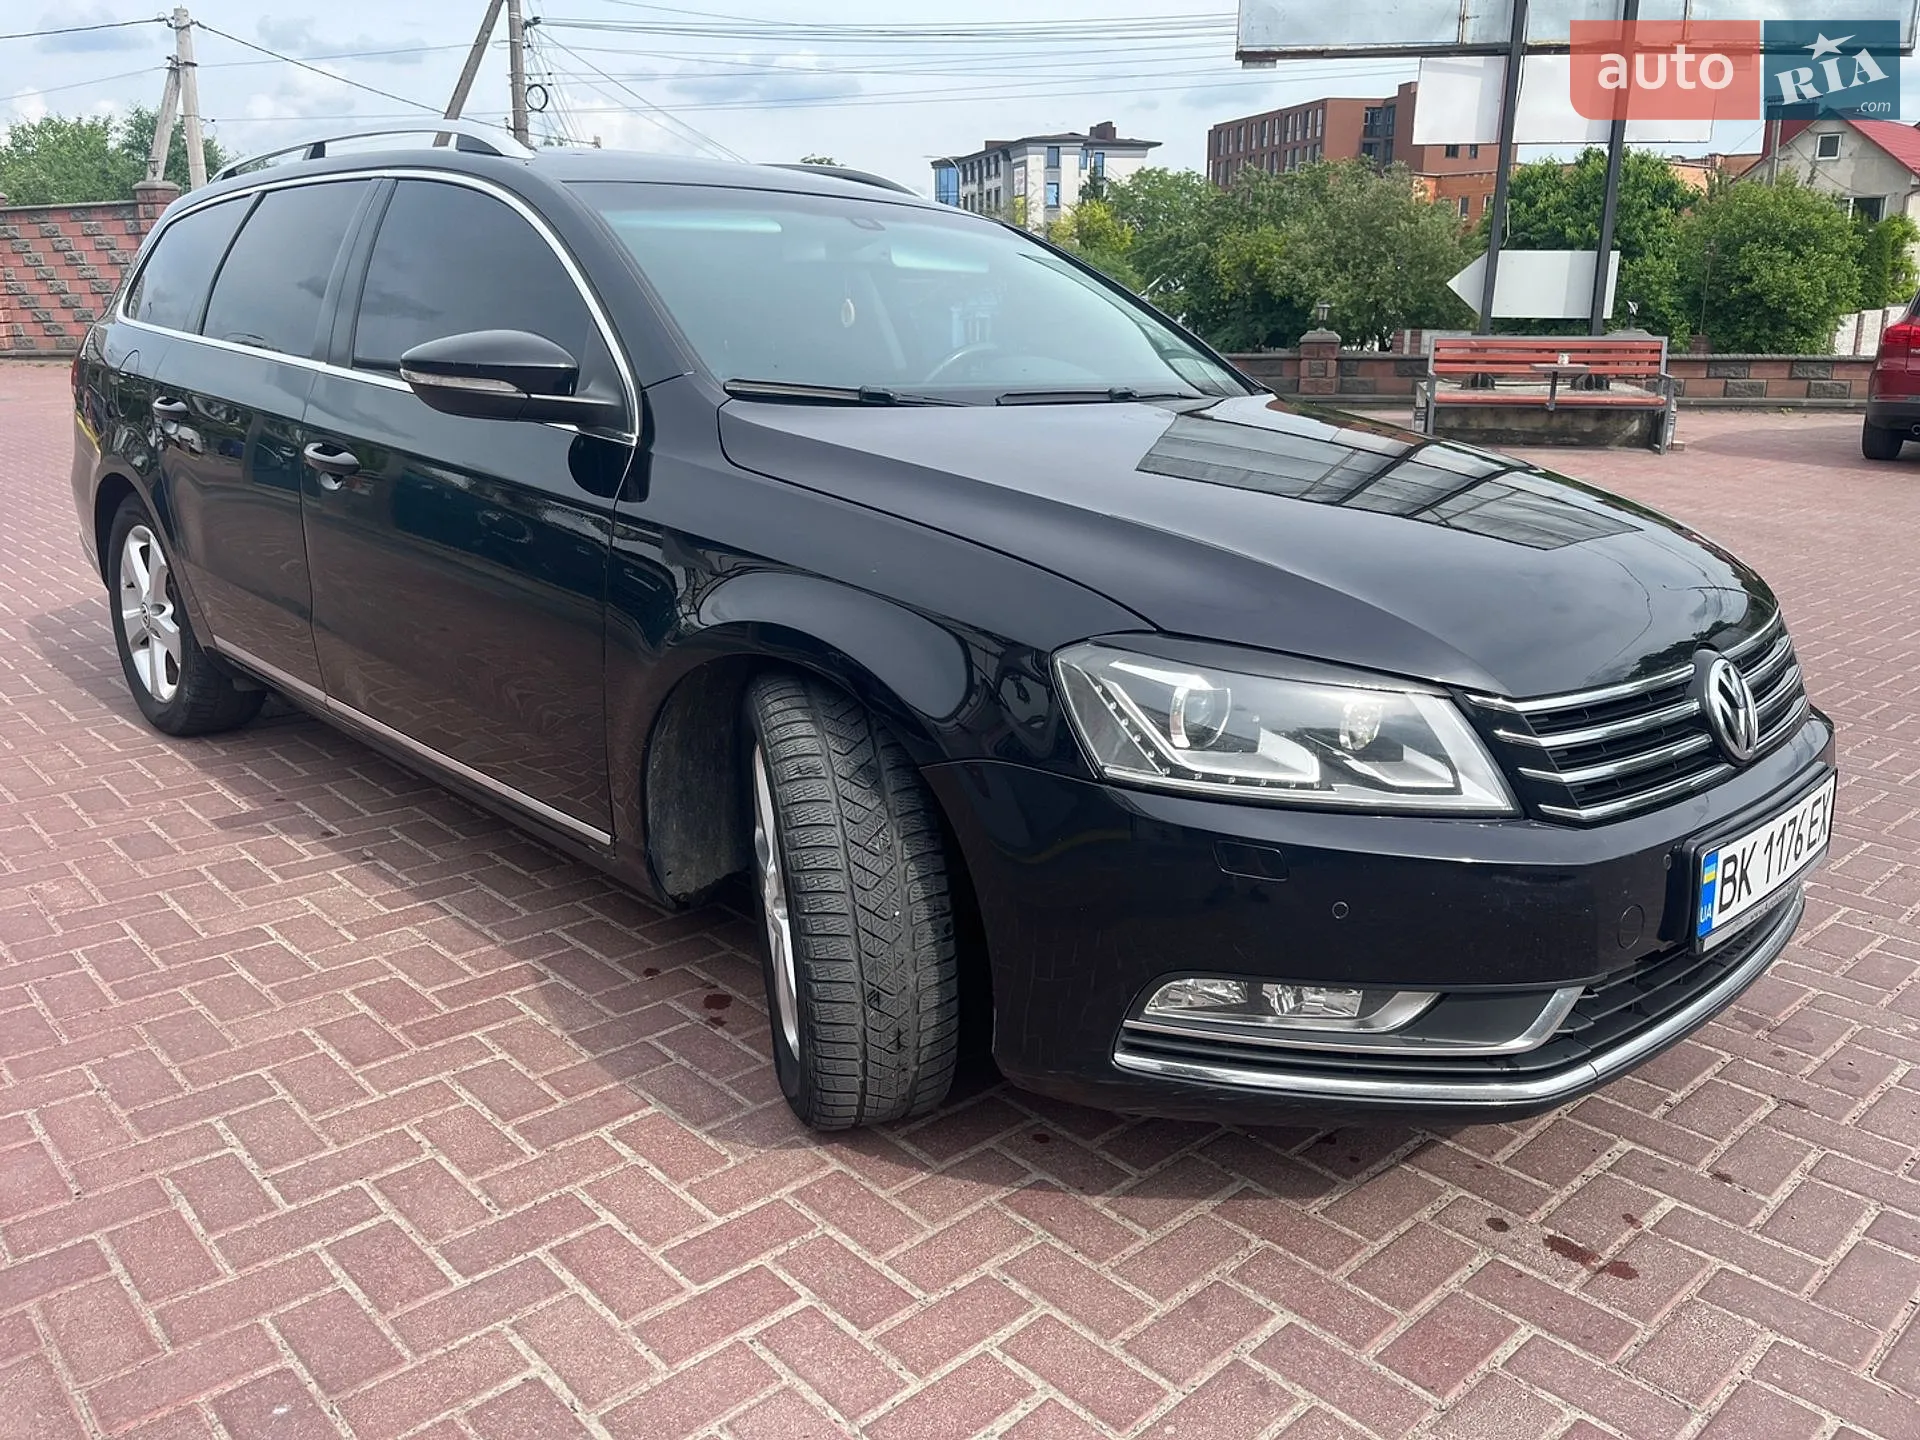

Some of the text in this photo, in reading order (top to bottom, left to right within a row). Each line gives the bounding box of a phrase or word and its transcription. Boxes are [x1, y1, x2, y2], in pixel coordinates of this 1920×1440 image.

[1718, 840, 1757, 914] BK
[1763, 808, 1807, 884] 1176
[1807, 787, 1832, 851] EX
[1700, 903, 1712, 923] UA
